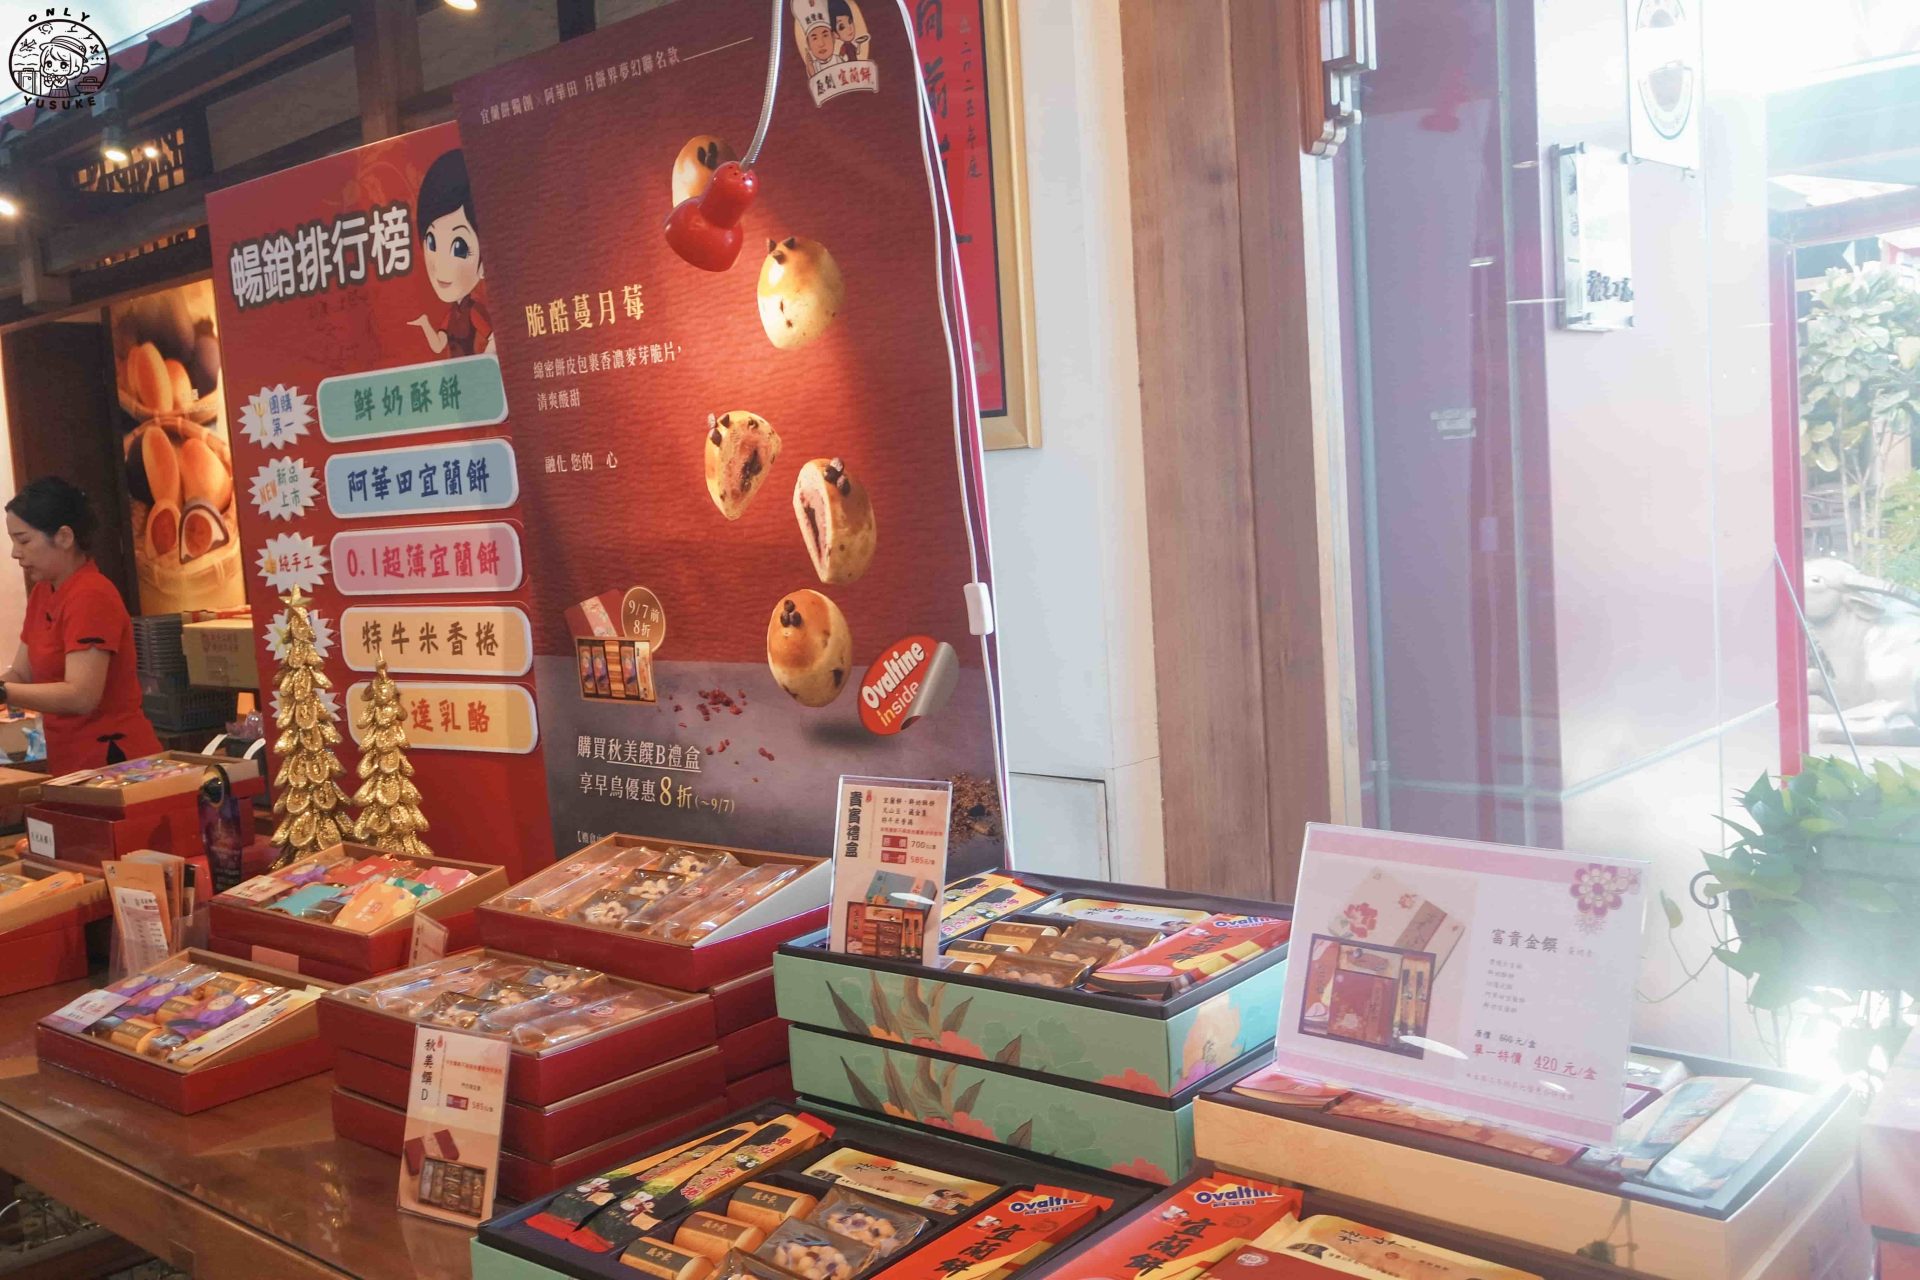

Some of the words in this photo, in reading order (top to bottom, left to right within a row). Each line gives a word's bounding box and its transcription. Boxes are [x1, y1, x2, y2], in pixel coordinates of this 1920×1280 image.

[229, 205, 411, 308] 暢銷排行榜
[525, 284, 645, 338] 脆酷蔓月莓
[354, 375, 462, 422] 鮮奶酥餅
[537, 388, 581, 411] 清爽酸甜
[260, 480, 278, 504] NEW
[347, 457, 490, 502] 阿華田宜蘭餅
[281, 488, 300, 508] 上市
[278, 552, 314, 572] 純手工
[347, 540, 500, 579] 0.1超薄宜蘭餅
[628, 600, 660, 623] 9/7前
[633, 619, 651, 638] 8折
[361, 619, 499, 657] 特牛米香捲
[862, 642, 925, 709] Ovaltine
[398, 698, 490, 733] 達乳酪
[876, 681, 920, 727] inside
[1534, 1055, 1558, 1072] 420
